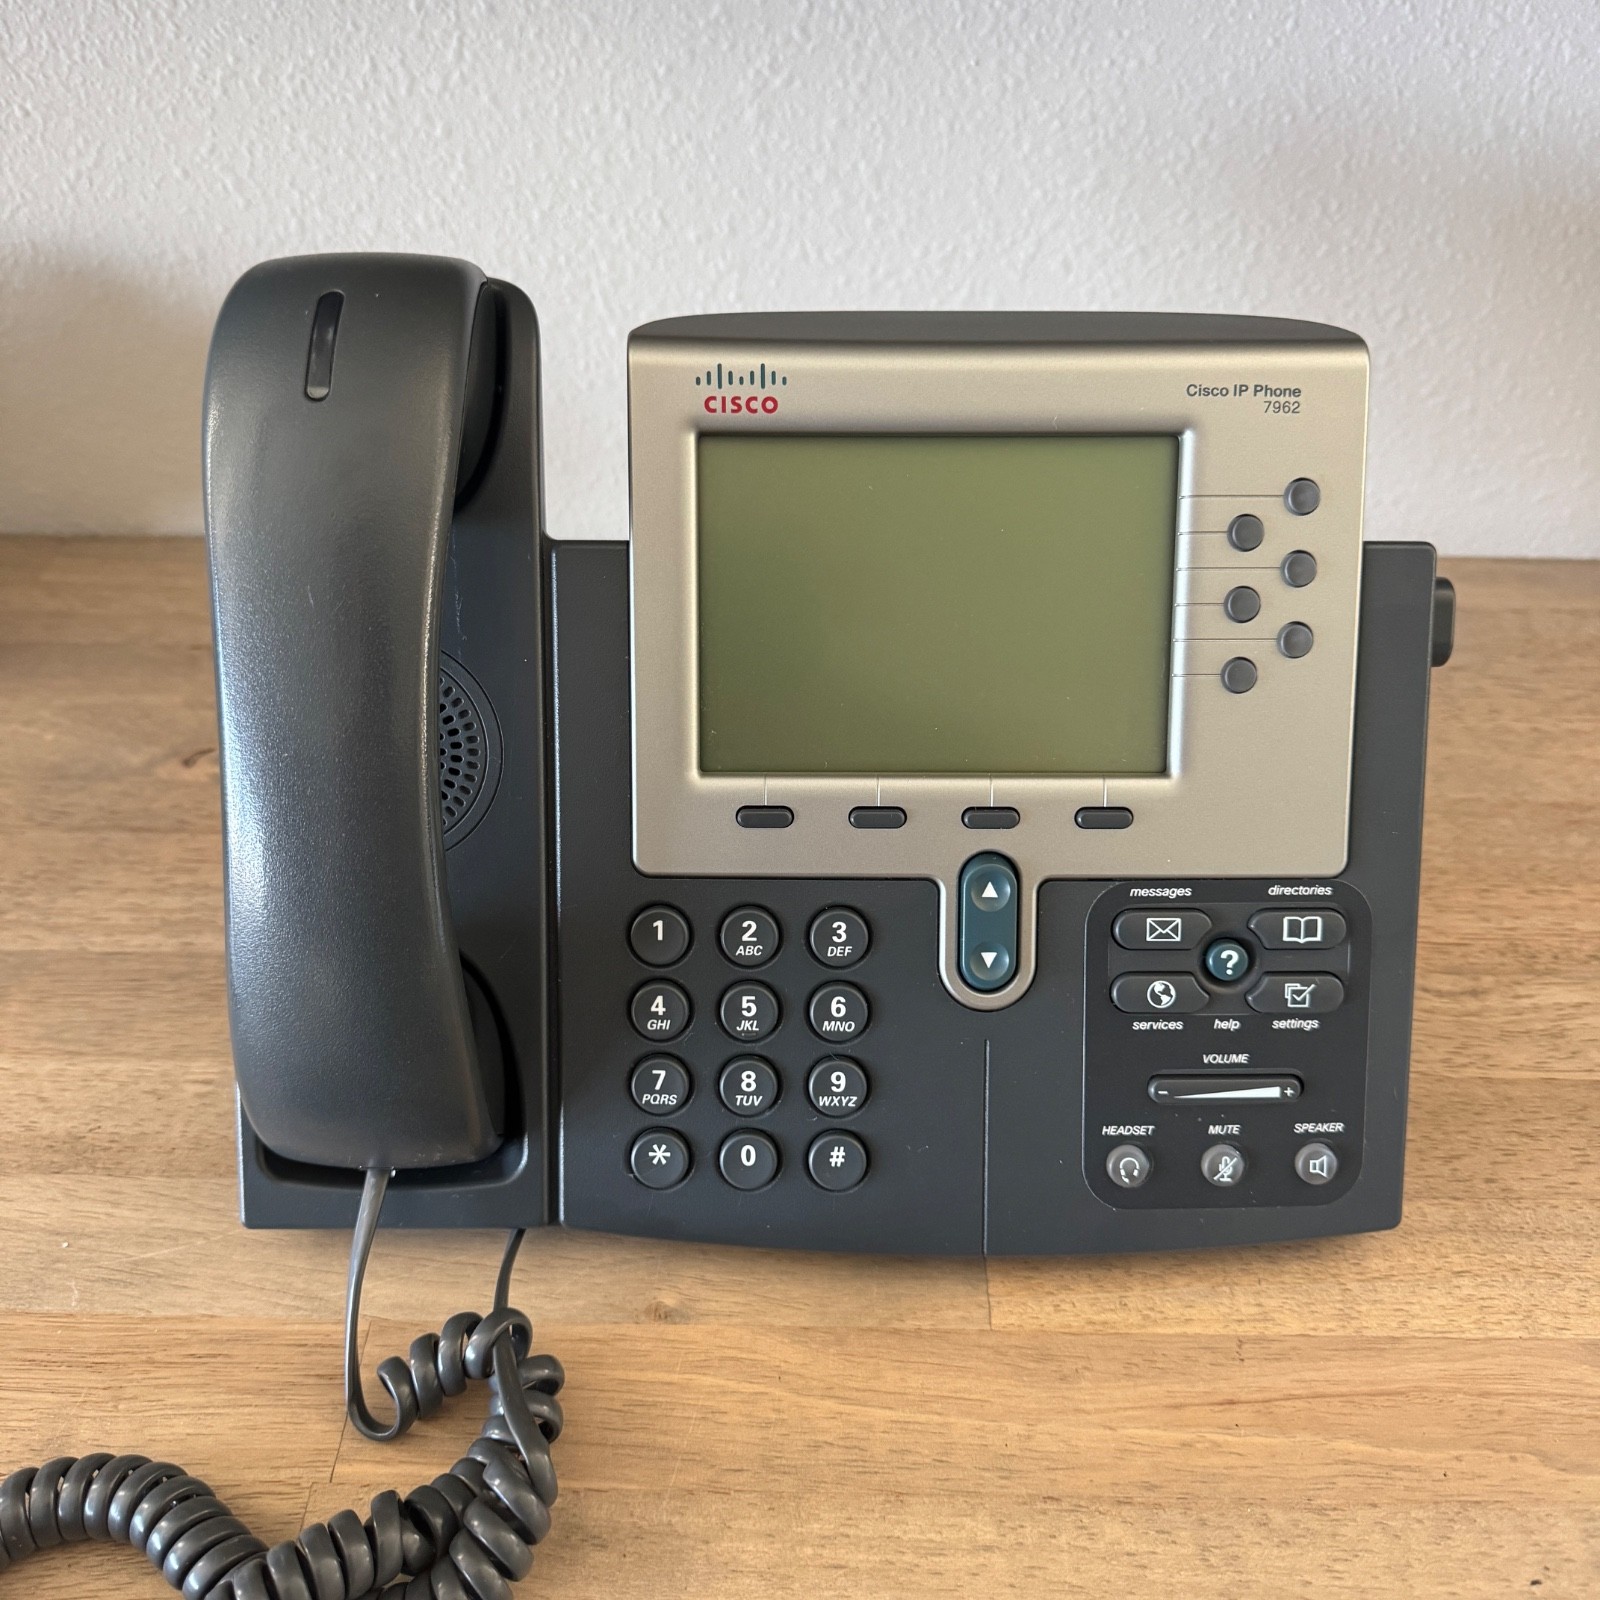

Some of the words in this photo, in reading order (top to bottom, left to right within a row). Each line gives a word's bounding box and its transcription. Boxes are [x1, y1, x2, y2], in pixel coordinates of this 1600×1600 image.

[1185, 383, 1230, 397] Cisco
[1233, 383, 1249, 397] IP
[1253, 384, 1302, 398] Phone
[703, 395, 779, 414] CISCO
[1263, 400, 1301, 414] 7962
[1129, 886, 1193, 899] messages
[1267, 884, 1333, 896] directories
[652, 919, 664, 941] 1
[741, 920, 758, 942] 2
[831, 921, 847, 943] 3
[735, 944, 763, 956] ABC
[827, 945, 853, 957] DEF
[1220, 949, 1239, 976] ?
[650, 995, 667, 1016] 4
[741, 995, 757, 1018] 5
[830, 995, 847, 1018] 6
[646, 1019, 671, 1031] GHI
[736, 1019, 760, 1031] JKL
[822, 1020, 856, 1033] MNO
[1132, 1019, 1184, 1031] services
[1213, 1018, 1241, 1032] help
[1271, 1017, 1320, 1032] settings
[1202, 1053, 1250, 1064] VOLUME
[651, 1069, 667, 1091] 7
[740, 1070, 757, 1093] 8
[830, 1071, 847, 1093] 9
[641, 1093, 678, 1106] PQRS
[735, 1094, 763, 1107] TUV
[818, 1095, 858, 1107] WXYZ
[1101, 1125, 1156, 1136] HEADSET
[1207, 1124, 1241, 1135] MUTE
[1293, 1122, 1345, 1134] SPEAKER
[740, 1144, 757, 1167] 0
[829, 1146, 846, 1168] #
